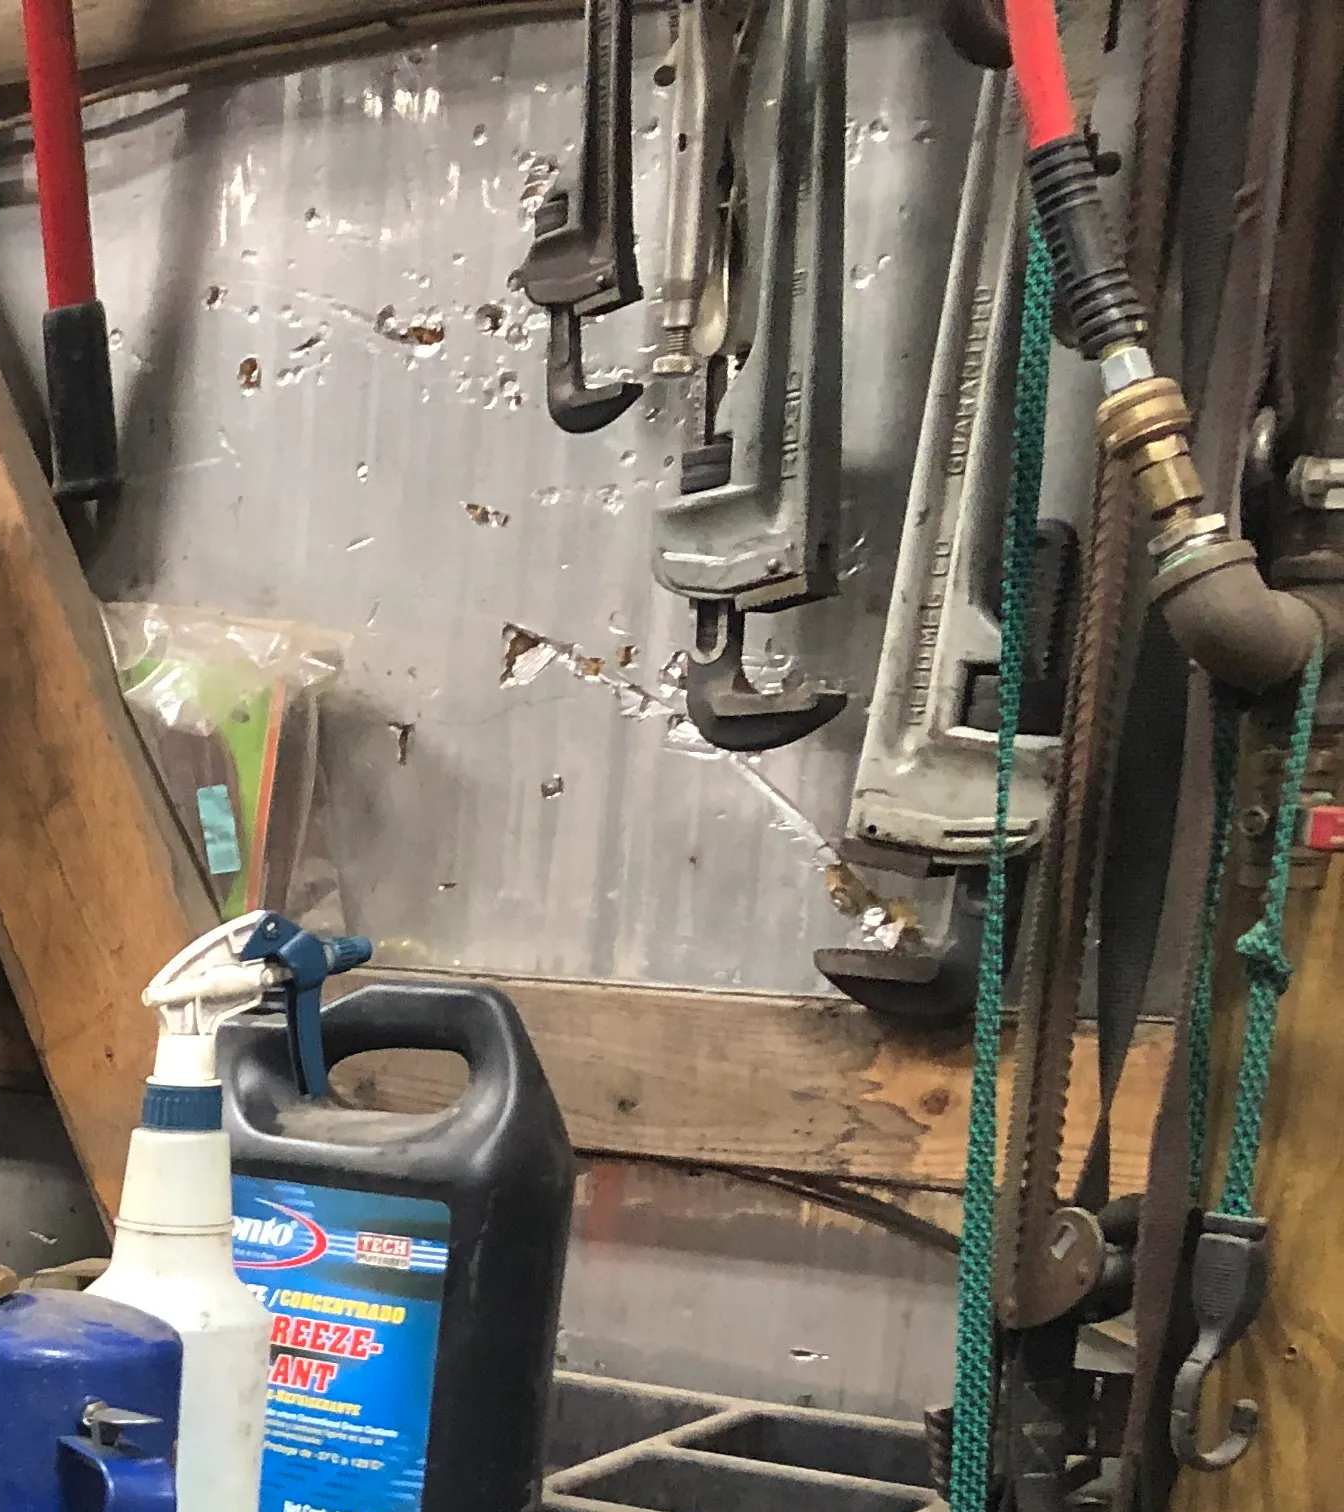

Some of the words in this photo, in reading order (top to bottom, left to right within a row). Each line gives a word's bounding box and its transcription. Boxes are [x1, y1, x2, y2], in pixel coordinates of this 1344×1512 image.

[232, 1215, 293, 1247] onto
[361, 1236, 408, 1255] TECH
[269, 1313, 384, 1361] REEZE-
[268, 1353, 339, 1393] ANT
